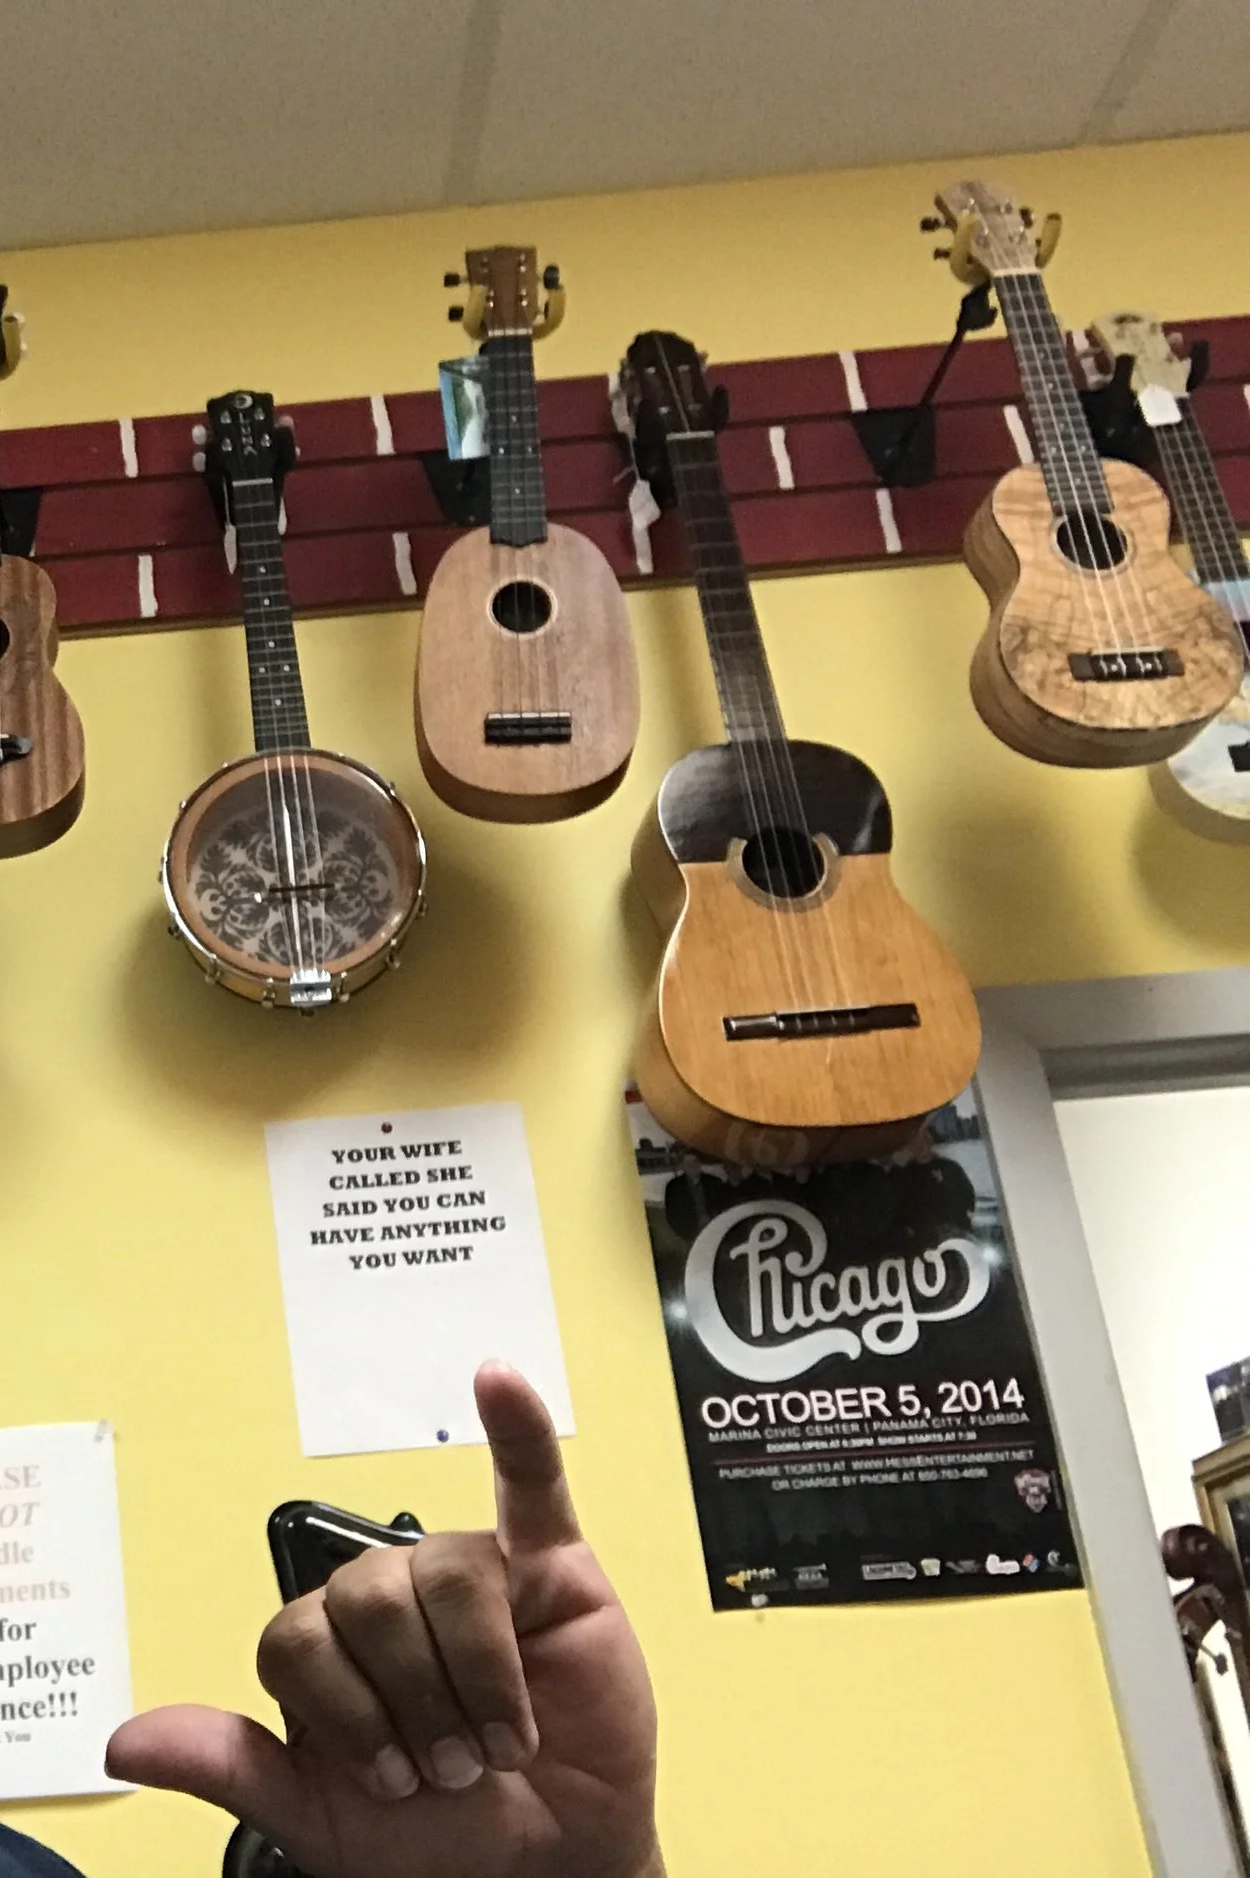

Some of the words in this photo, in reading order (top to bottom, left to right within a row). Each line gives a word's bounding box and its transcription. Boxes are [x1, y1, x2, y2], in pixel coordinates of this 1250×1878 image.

[331, 1145, 395, 1164] YOUR
[400, 1139, 463, 1159] WIFE
[329, 1168, 421, 1190] CALLED
[427, 1165, 473, 1184] SHE
[323, 1198, 378, 1218] SAID
[383, 1195, 431, 1214] YOU
[436, 1190, 486, 1209] CAN
[310, 1226, 375, 1246] HAVE
[380, 1215, 507, 1242] ANYTHING
[349, 1252, 398, 1271] YOU
[402, 1245, 474, 1266] WANT
[684, 1200, 992, 1384] Chicago
[701, 1386, 893, 1429] OCTOBER
[898, 1384, 931, 1420] 5,
[937, 1376, 1025, 1414] 2014
[708, 1428, 762, 1443] MARINA
[764, 1425, 801, 1440] CIVIC
[805, 1422, 861, 1437] CENTER
[873, 1418, 929, 1431] PANAMA
[969, 1412, 1030, 1427] FLORIDA
[719, 1465, 781, 1480] PURCHASE
[783, 1462, 831, 1476] TICKETS
[833, 1460, 846, 1473] AT
[772, 1479, 790, 1491] OR
[791, 1476, 839, 1490] CHARGE
[842, 1474, 857, 1486] BY
[859, 1471, 899, 1486] PHONE
[902, 1470, 915, 1482] AT
[4, 1731, 32, 1746] You
